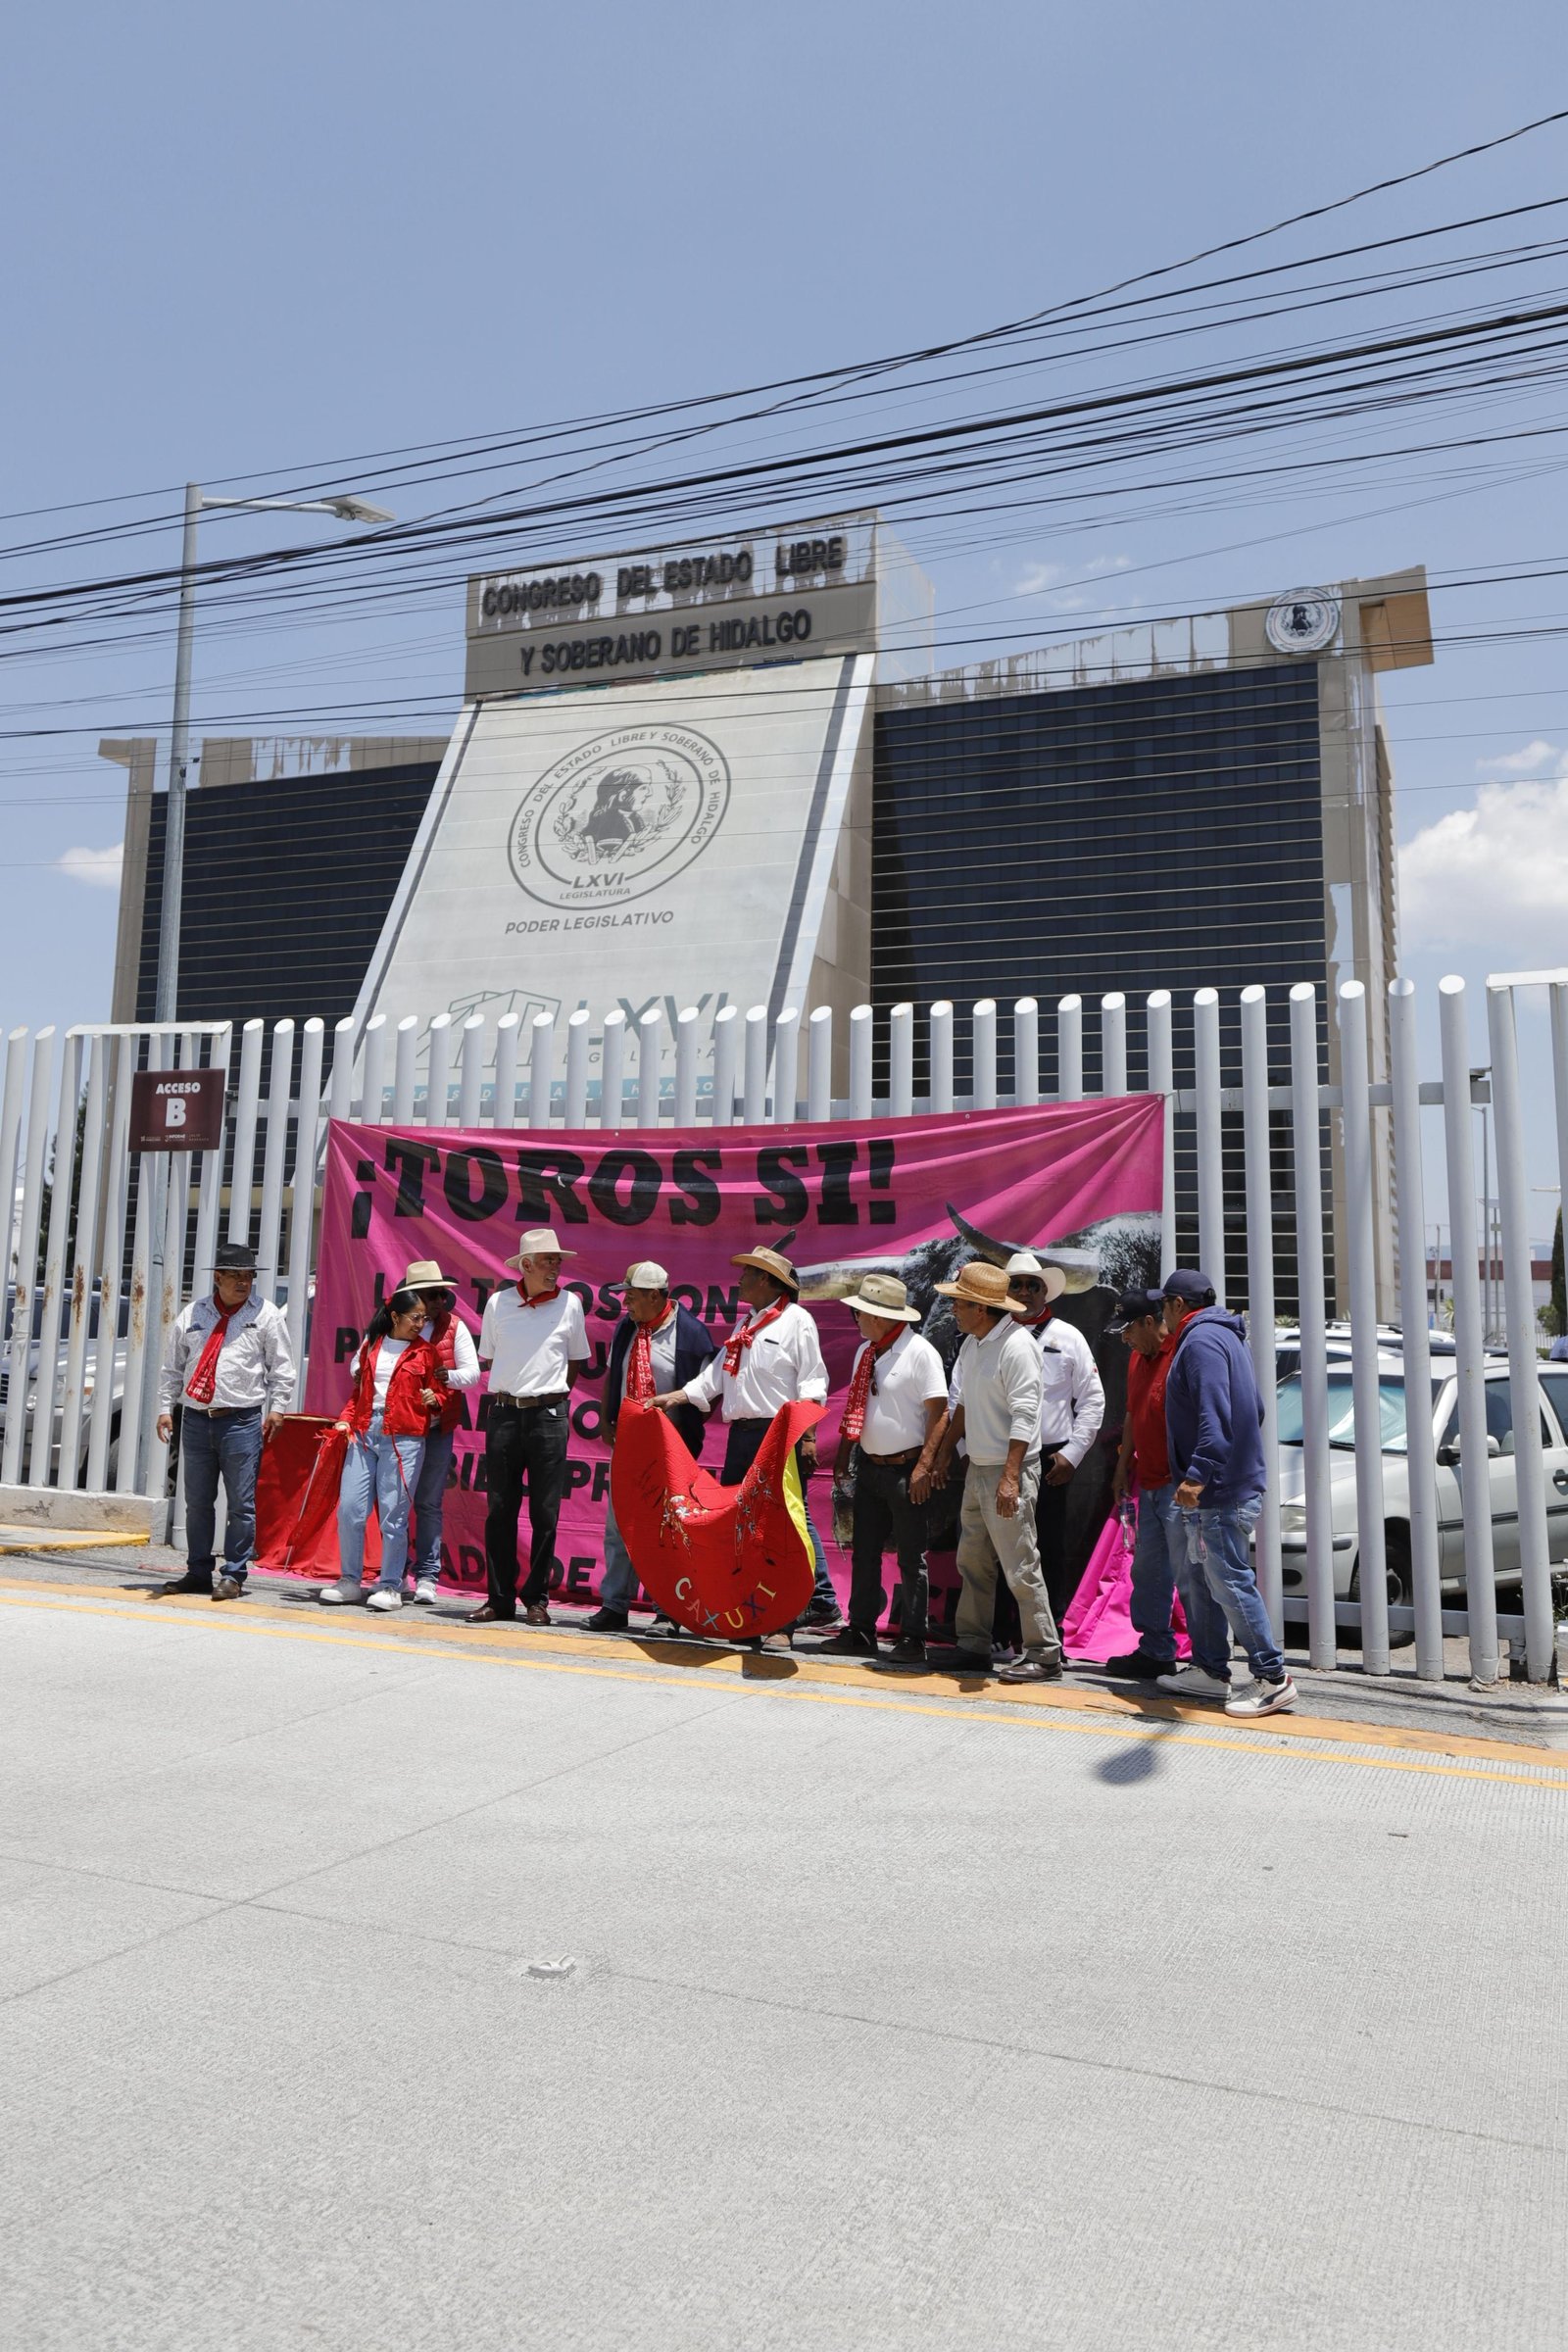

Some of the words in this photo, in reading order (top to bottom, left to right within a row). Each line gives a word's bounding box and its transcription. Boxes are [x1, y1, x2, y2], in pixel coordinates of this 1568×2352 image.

[482, 571, 601, 615] CONGRESO
[617, 565, 655, 597] DEL
[663, 550, 753, 589] ESTADO
[775, 536, 845, 576] LIBRE
[520, 646, 535, 676] Y
[541, 629, 662, 673] SOBERANO
[671, 626, 700, 658] DE
[710, 609, 811, 652] HIDALGO
[611, 731, 646, 747] LIBRE
[649, 731, 658, 740] Y
[662, 732, 714, 766] SOBERANO
[554, 745, 602, 779] ESTADO
[708, 769, 721, 785] DE
[533, 782, 554, 803] DEL
[691, 791, 720, 845] HIDALGO
[517, 809, 534, 868] CONGRESO
[560, 887, 630, 901] LEGISLATURA
[572, 871, 624, 889] LXVI
[505, 919, 560, 934] PODER
[564, 910, 674, 930] LEGISLATIVO
[156, 1082, 201, 1095] ACCESO
[166, 1098, 186, 1127] B
[756, 1139, 897, 1226] SI!
[374, 1272, 457, 1313] LS
[668, 1284, 740, 1323] ON
[675, 1577, 777, 1632] CAXUXI
